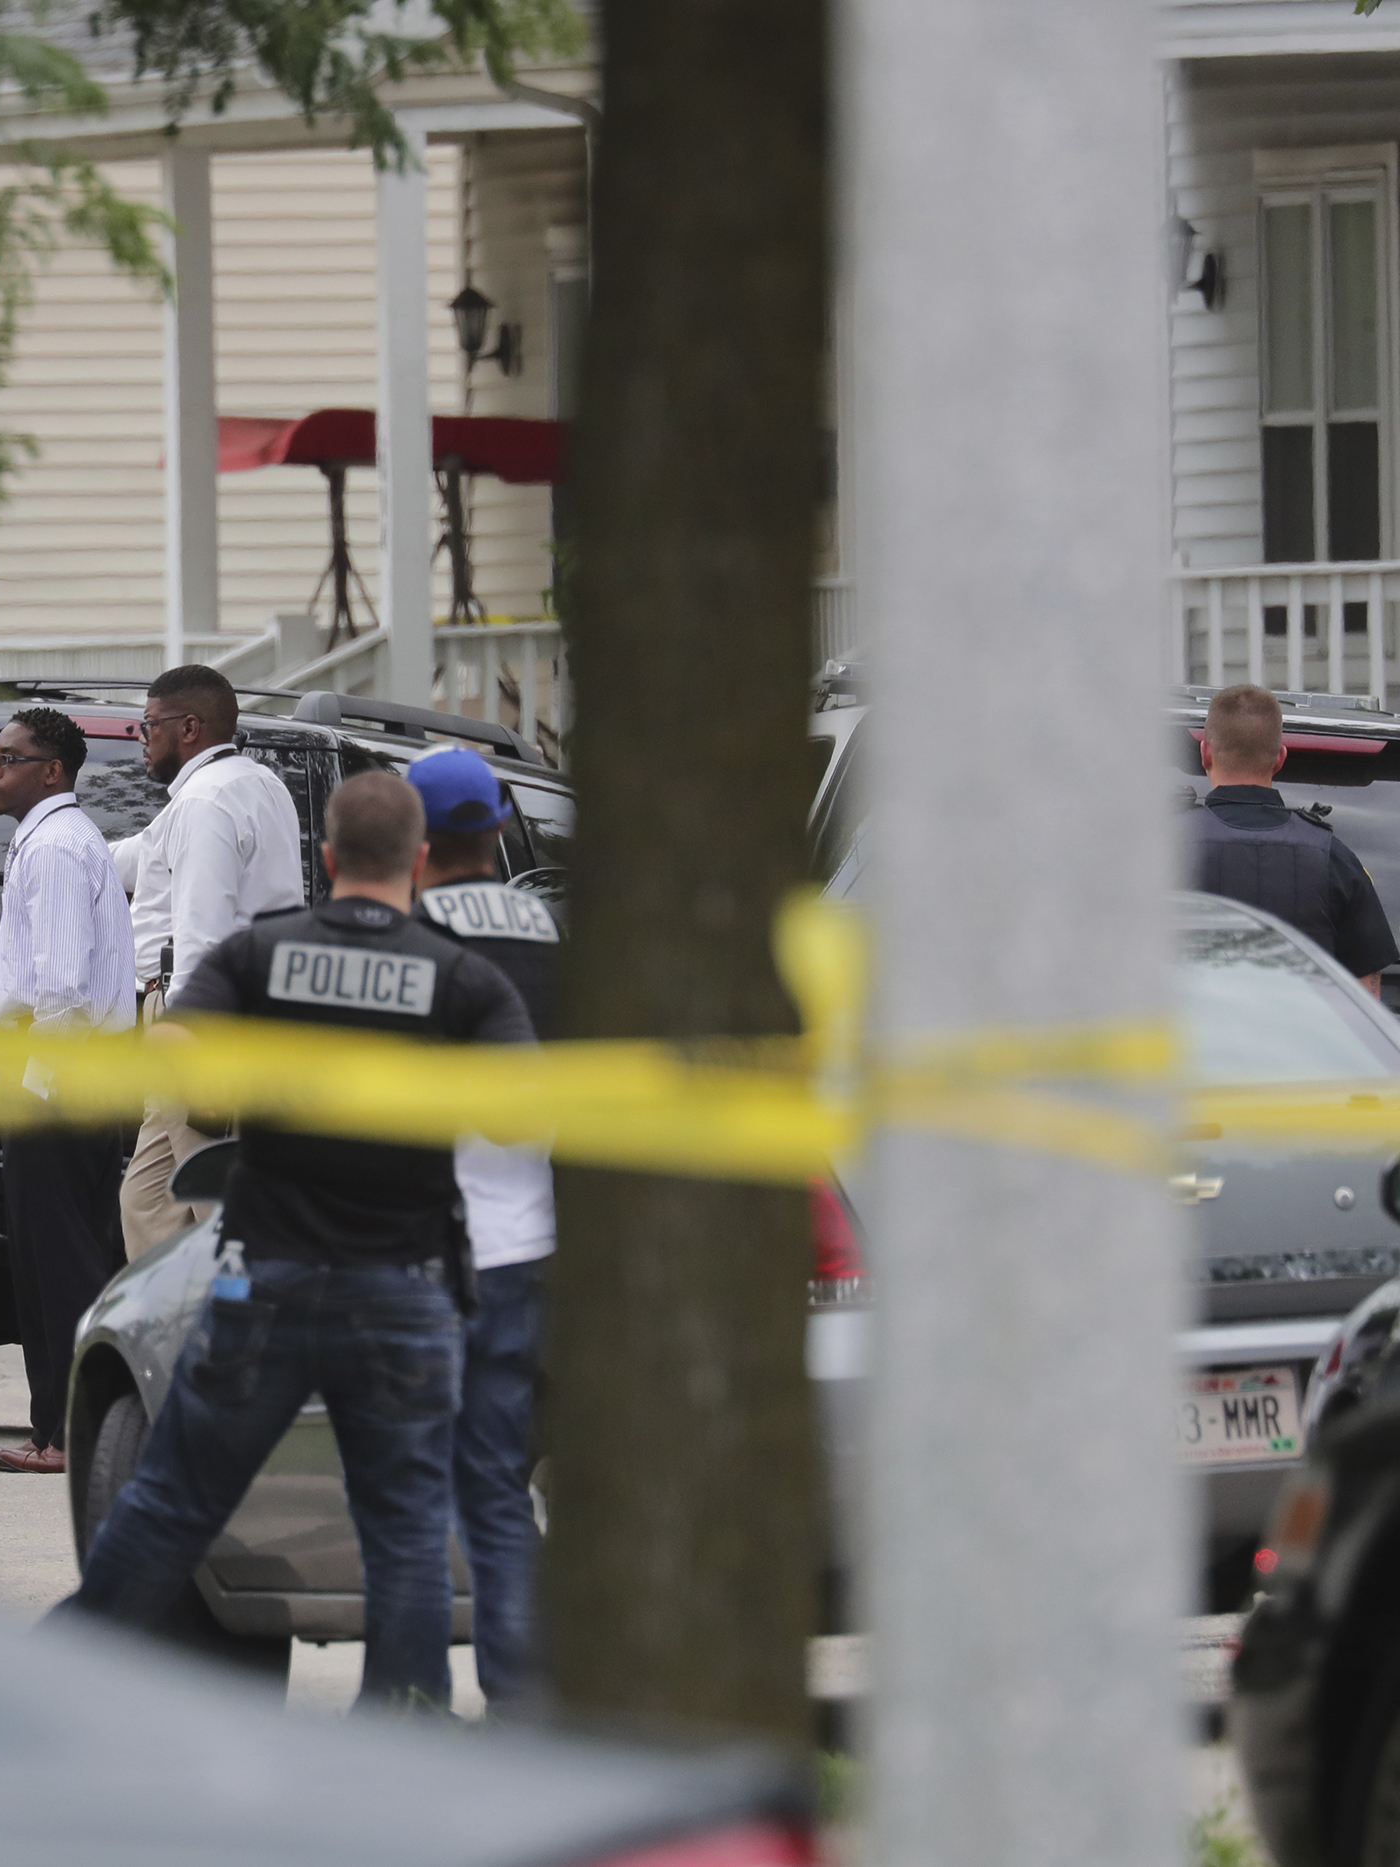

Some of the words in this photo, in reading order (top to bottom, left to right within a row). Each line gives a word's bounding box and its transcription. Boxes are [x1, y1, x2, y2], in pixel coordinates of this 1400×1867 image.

[436, 890, 553, 936] POLICE
[284, 950, 420, 1007] POLICE
[1177, 1396, 1282, 1444] 3-MMR
